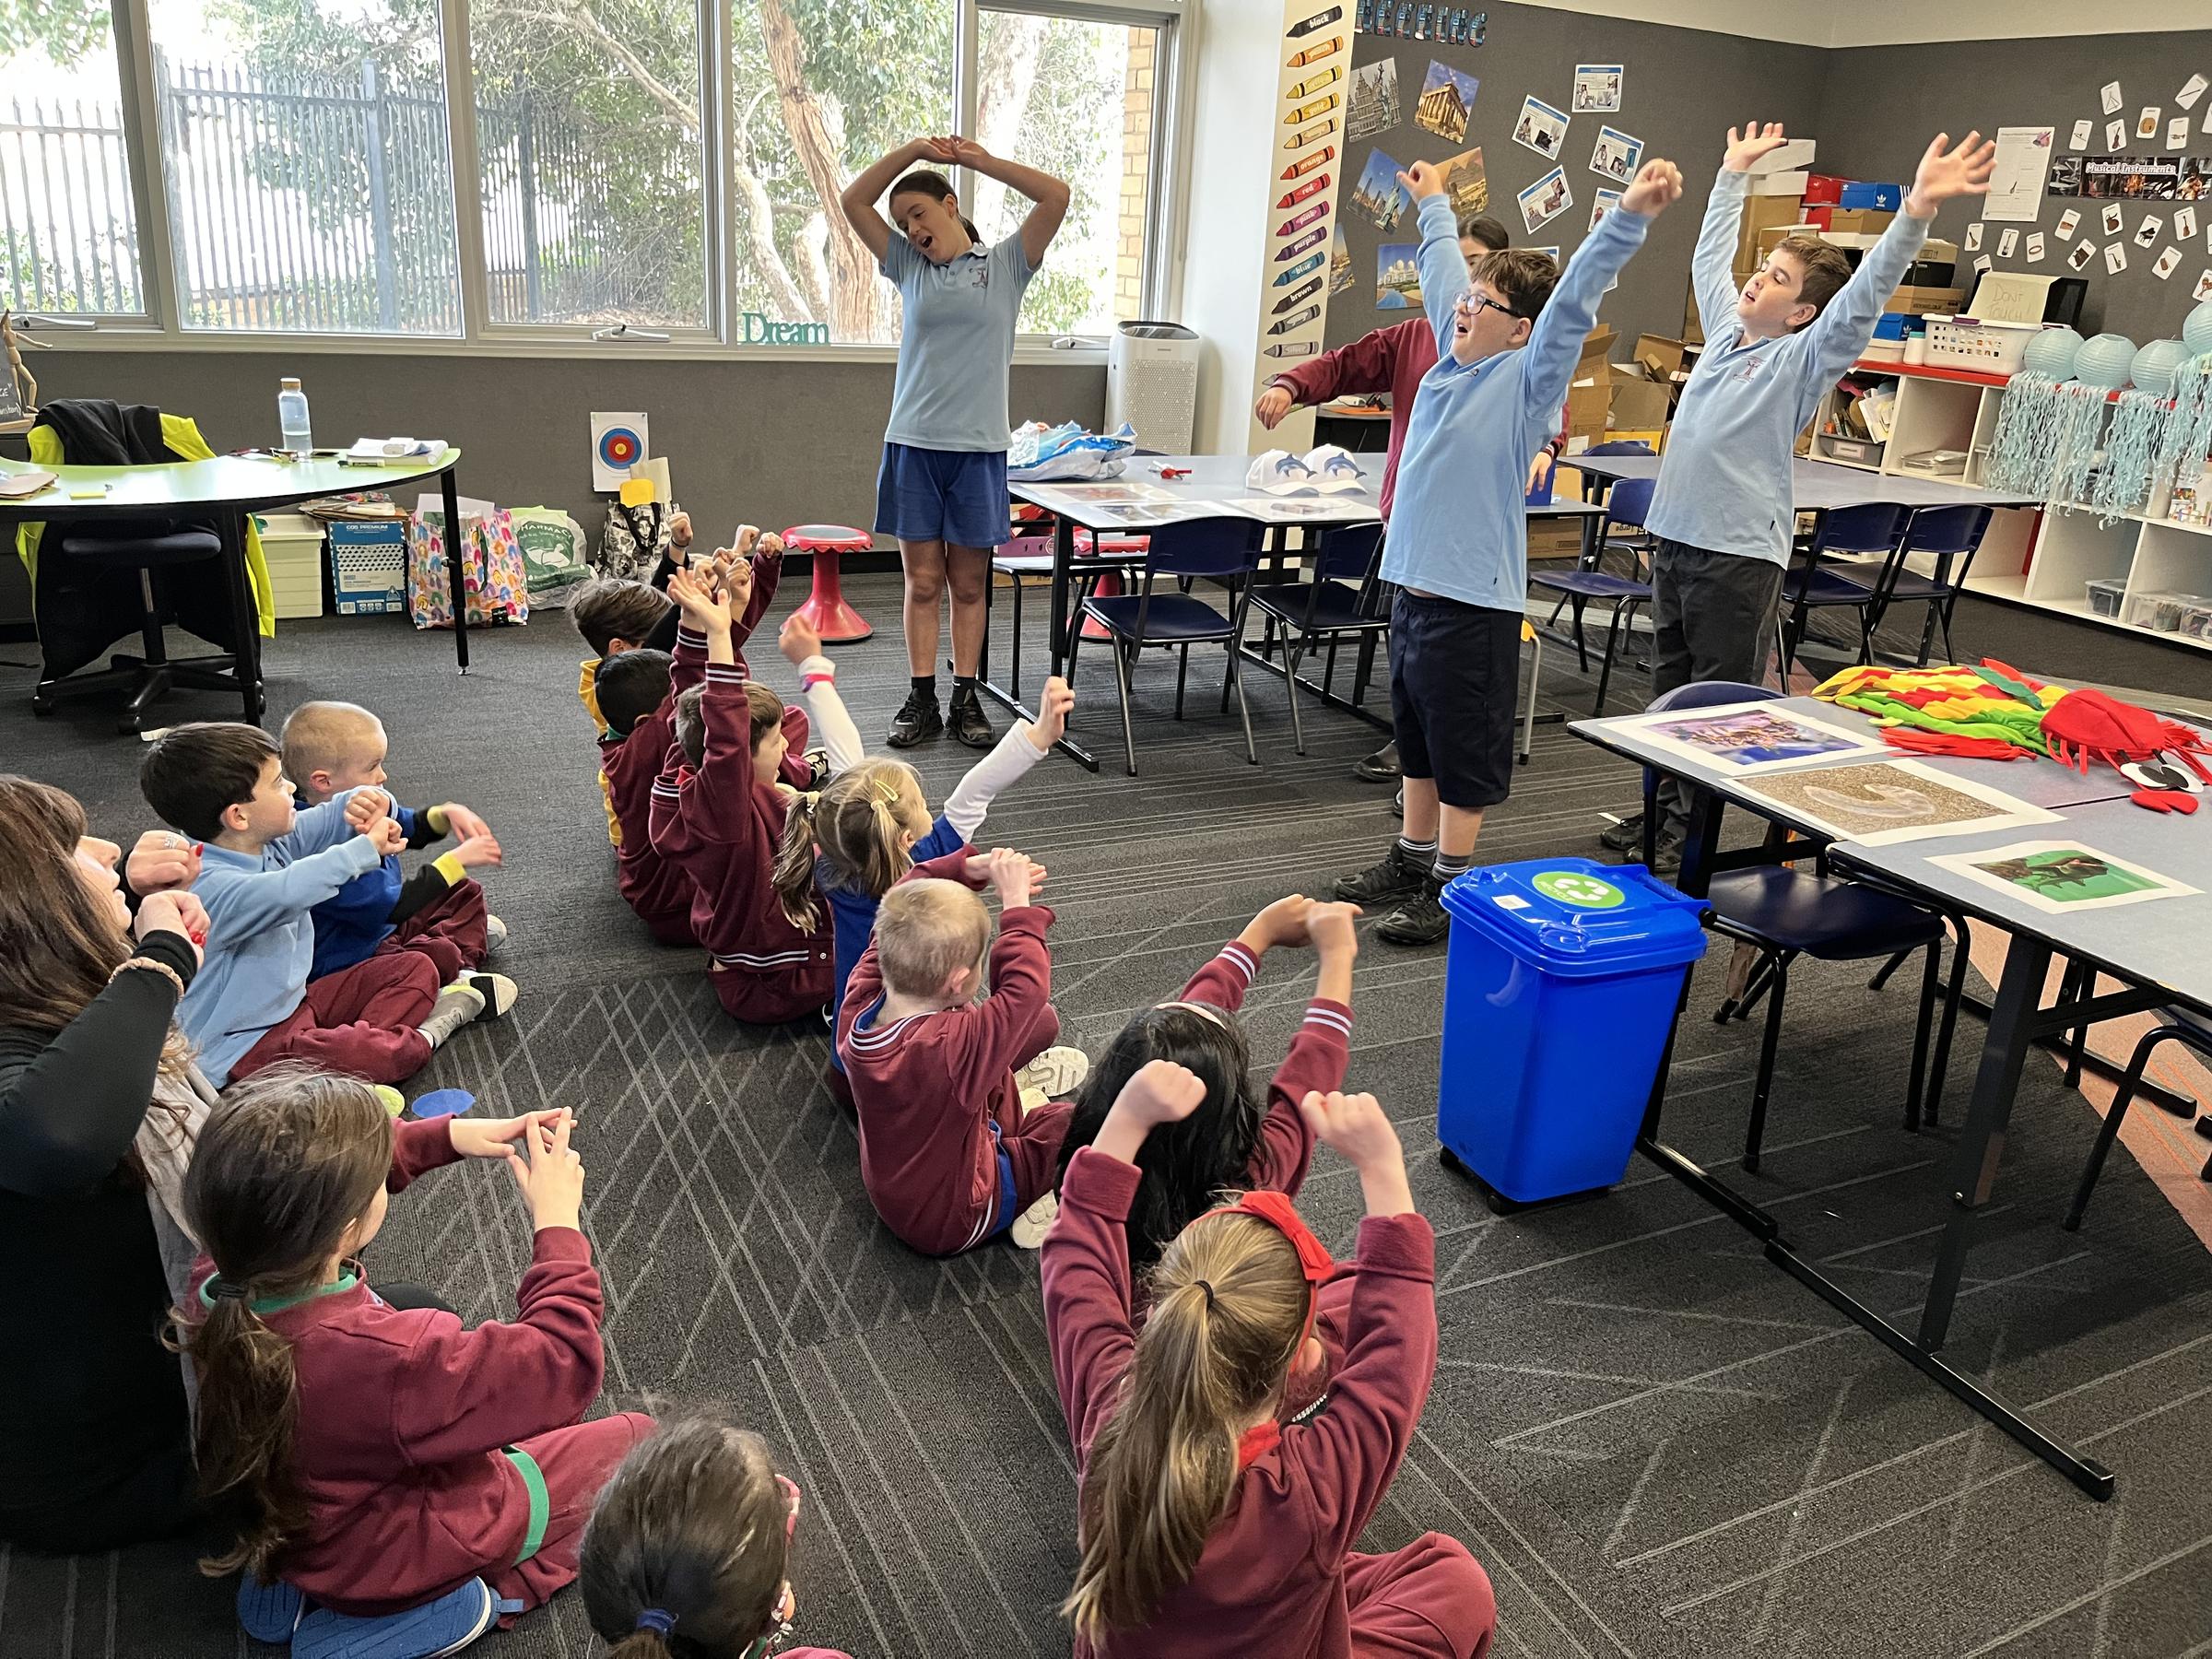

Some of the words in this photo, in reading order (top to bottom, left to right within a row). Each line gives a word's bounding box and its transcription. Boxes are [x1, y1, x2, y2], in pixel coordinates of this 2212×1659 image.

[1309, 13, 1330, 29] black
[1300, 154, 1324, 170] orange
[2086, 162, 2120, 174] Musical
[2120, 163, 2176, 175] Instruments
[1302, 183, 1314, 195] red
[1300, 209, 1317, 225] pink
[1293, 234, 1316, 252] purple
[1295, 261, 1312, 275] blue
[1290, 285, 1313, 302] brown
[739, 312, 831, 345] Dream
